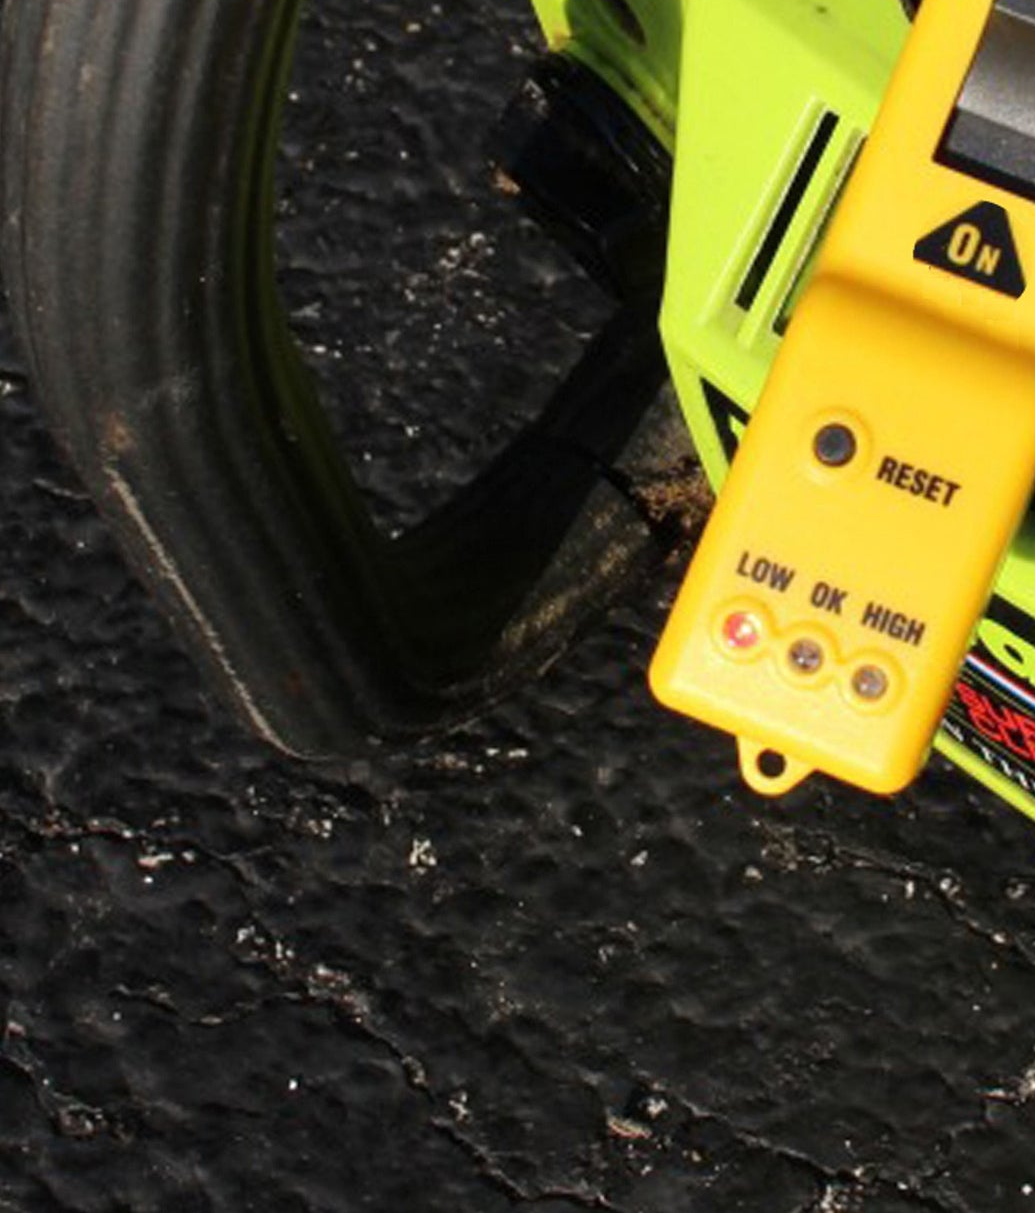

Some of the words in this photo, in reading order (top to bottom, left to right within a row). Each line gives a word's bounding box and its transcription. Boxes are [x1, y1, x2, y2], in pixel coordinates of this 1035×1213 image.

[875, 455, 961, 508] RESET
[735, 551, 795, 594] LOW
[809, 581, 847, 615] OK
[860, 601, 926, 647] HIGH
